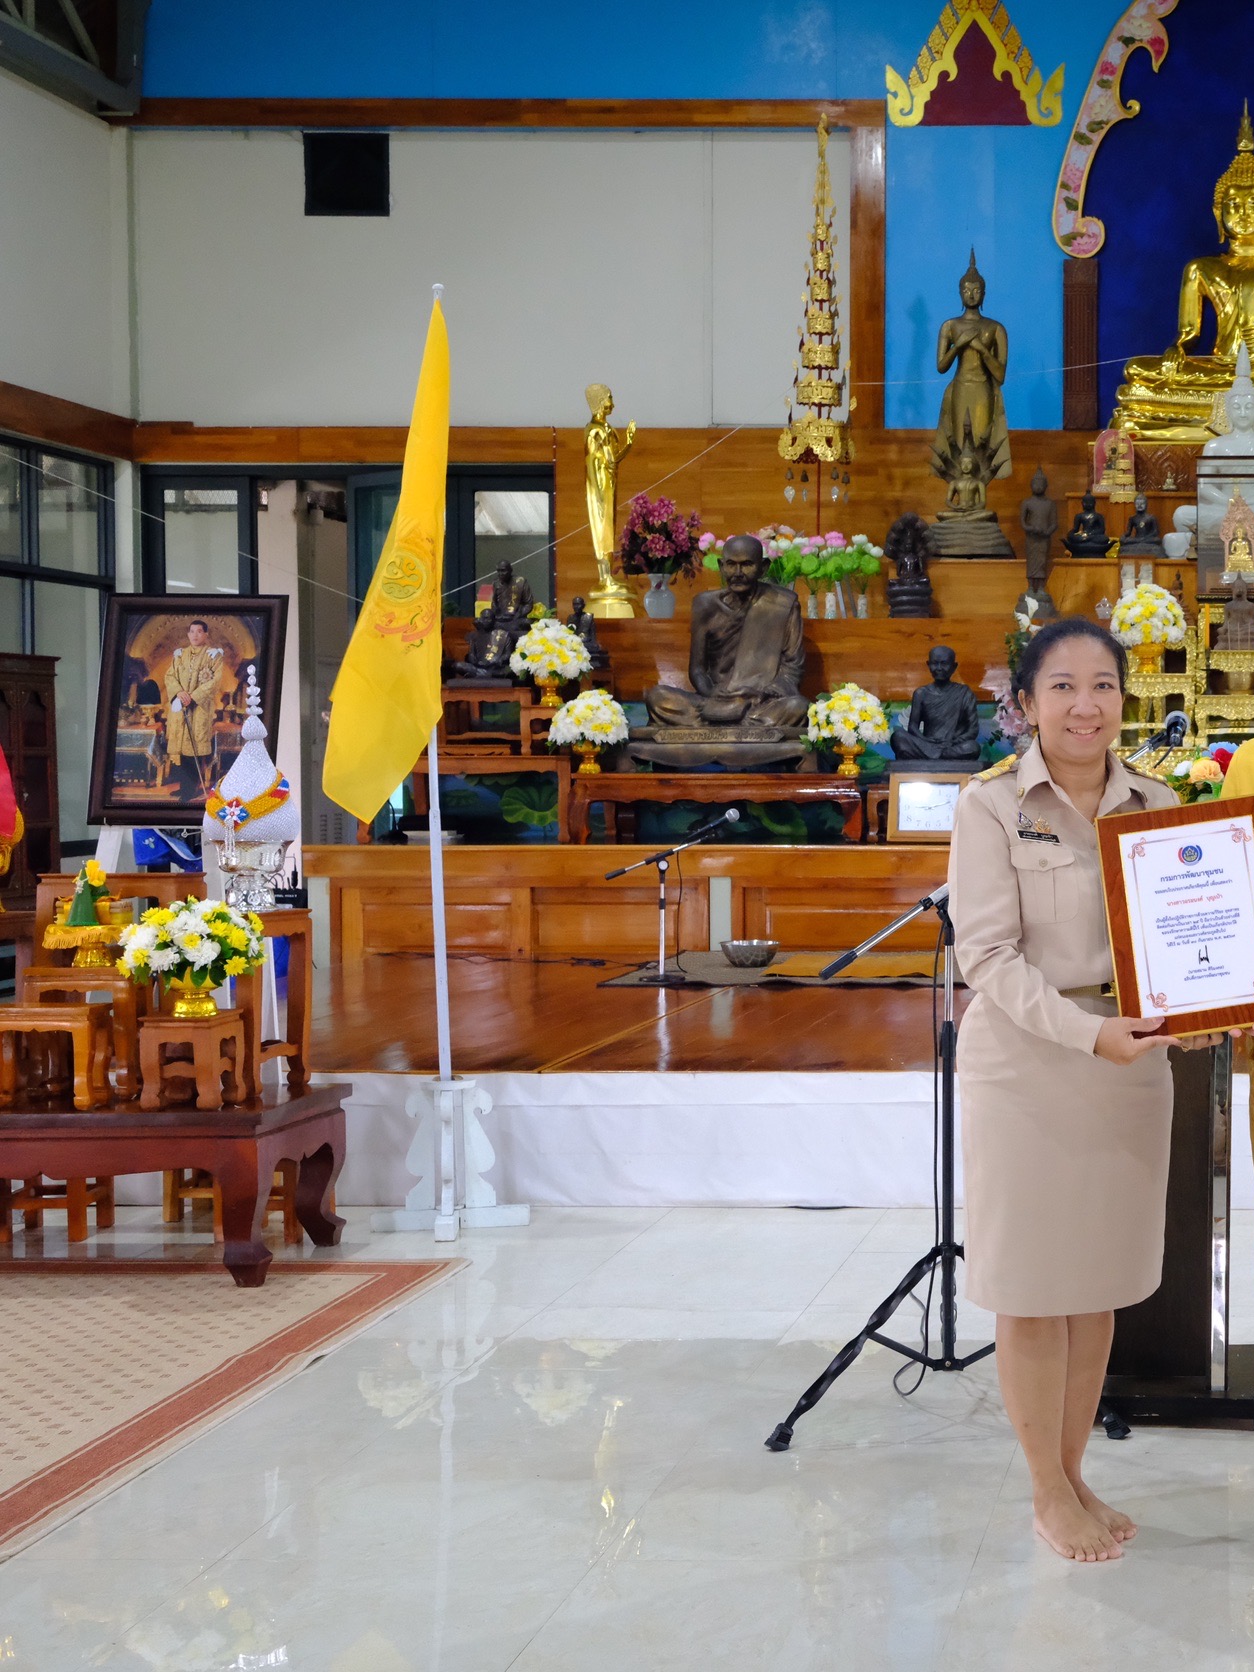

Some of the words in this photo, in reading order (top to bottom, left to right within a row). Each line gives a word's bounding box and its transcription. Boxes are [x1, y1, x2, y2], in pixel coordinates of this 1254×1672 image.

[1160, 868, 1224, 883] กรมการพัฒนาชุมชน
